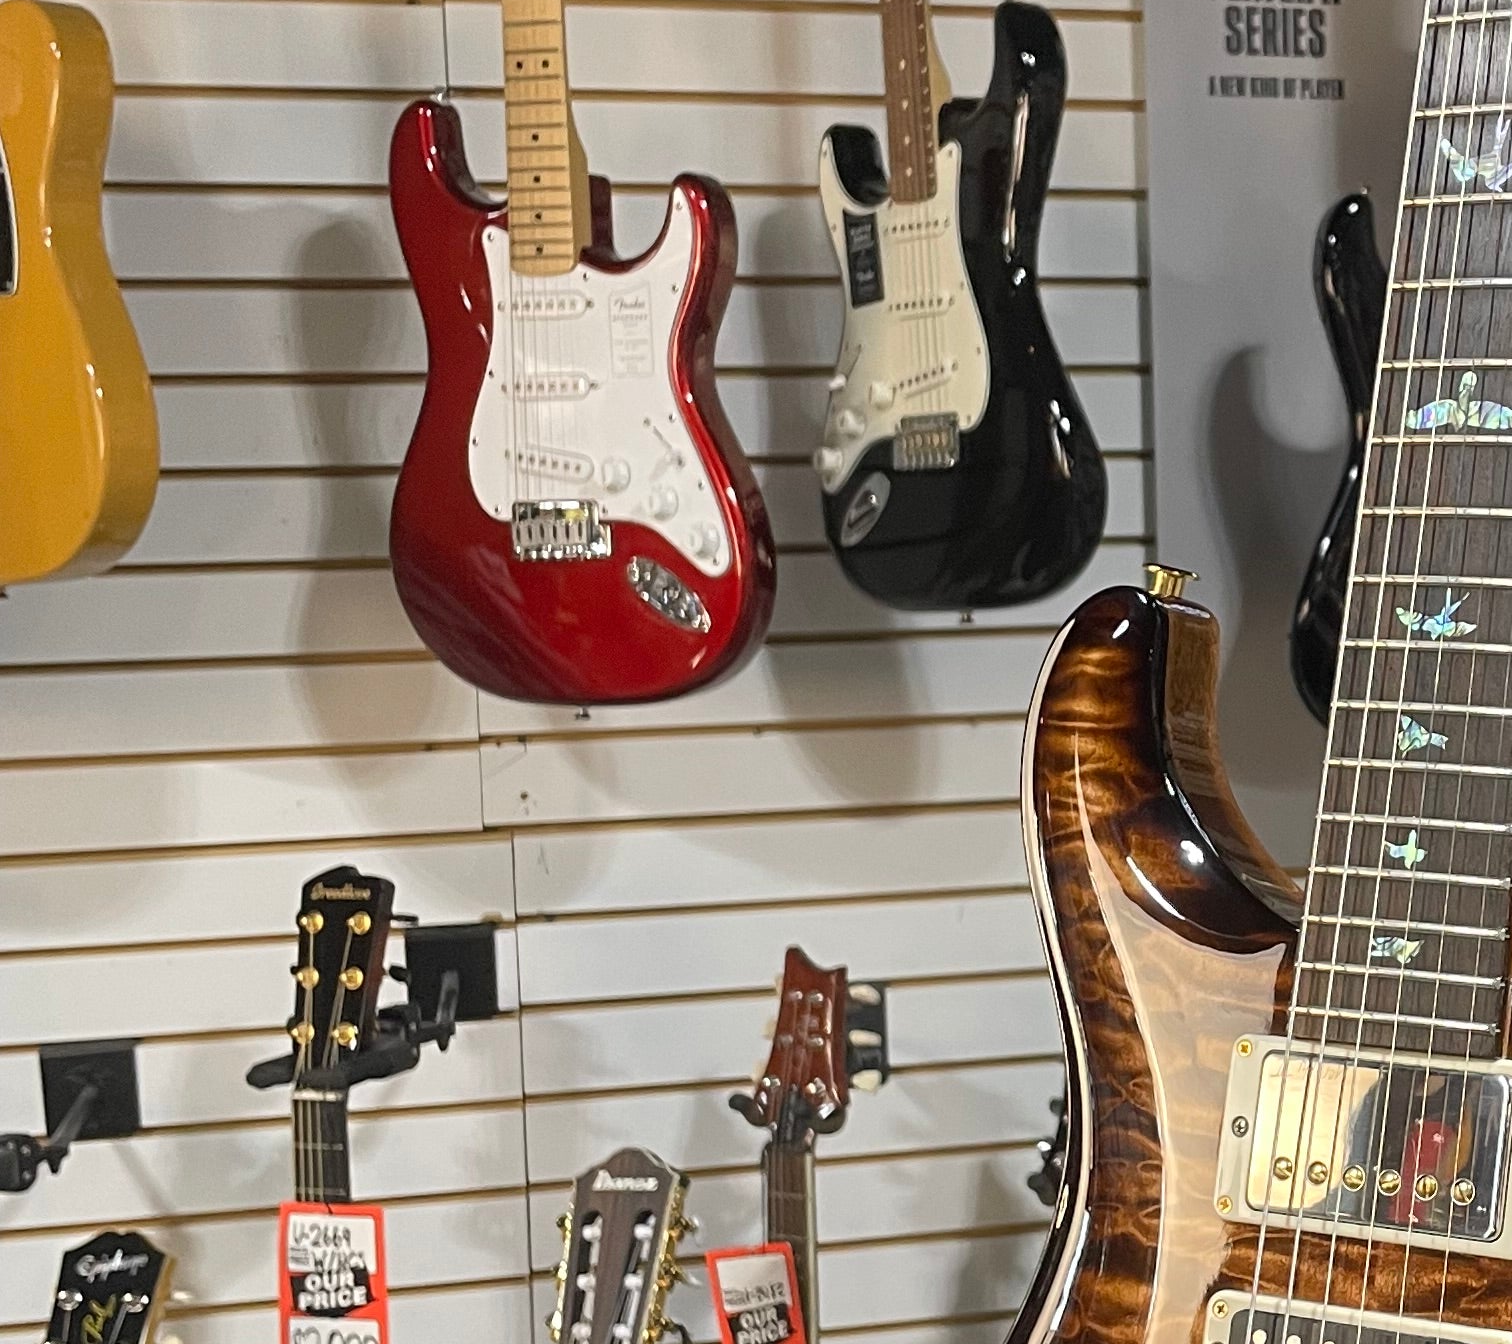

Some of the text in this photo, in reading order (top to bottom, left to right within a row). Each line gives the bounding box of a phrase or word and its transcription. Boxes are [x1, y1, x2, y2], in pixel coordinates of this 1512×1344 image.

[1225, 6, 1326, 57] SERIES
[1300, 79, 1344, 100] PLAYER
[304, 1272, 355, 1293] OUR
[298, 1286, 368, 1311] PRICE
[739, 1307, 778, 1329] OUR
